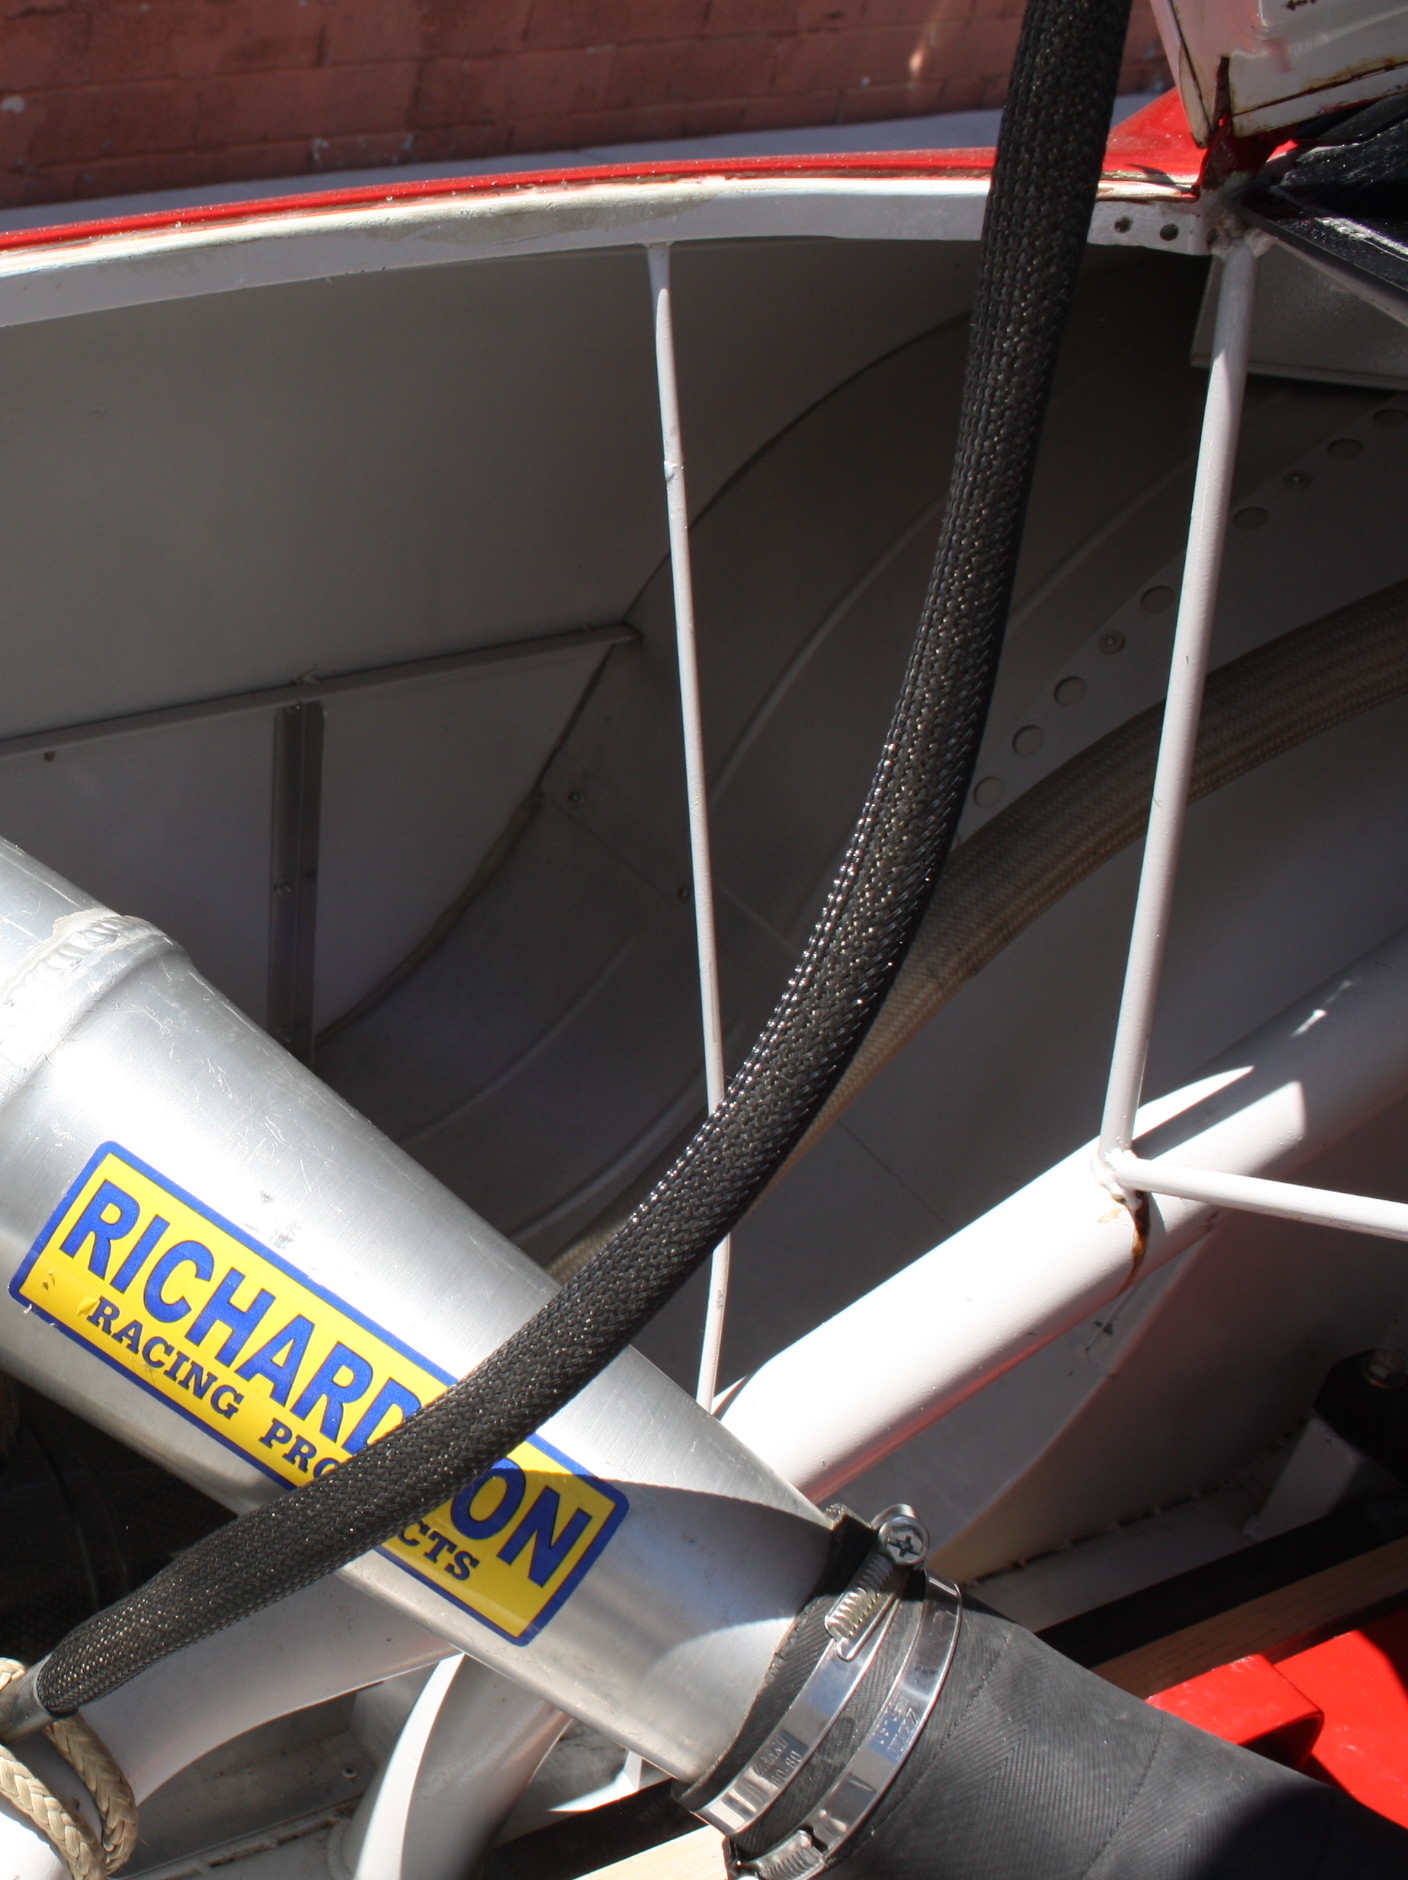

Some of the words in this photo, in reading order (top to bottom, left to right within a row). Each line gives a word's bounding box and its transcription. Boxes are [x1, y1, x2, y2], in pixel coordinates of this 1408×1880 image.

[58, 1178, 593, 1588] RICHARDON
[86, 1295, 244, 1420] RACING
[258, 1416, 481, 1581] PROCTS
